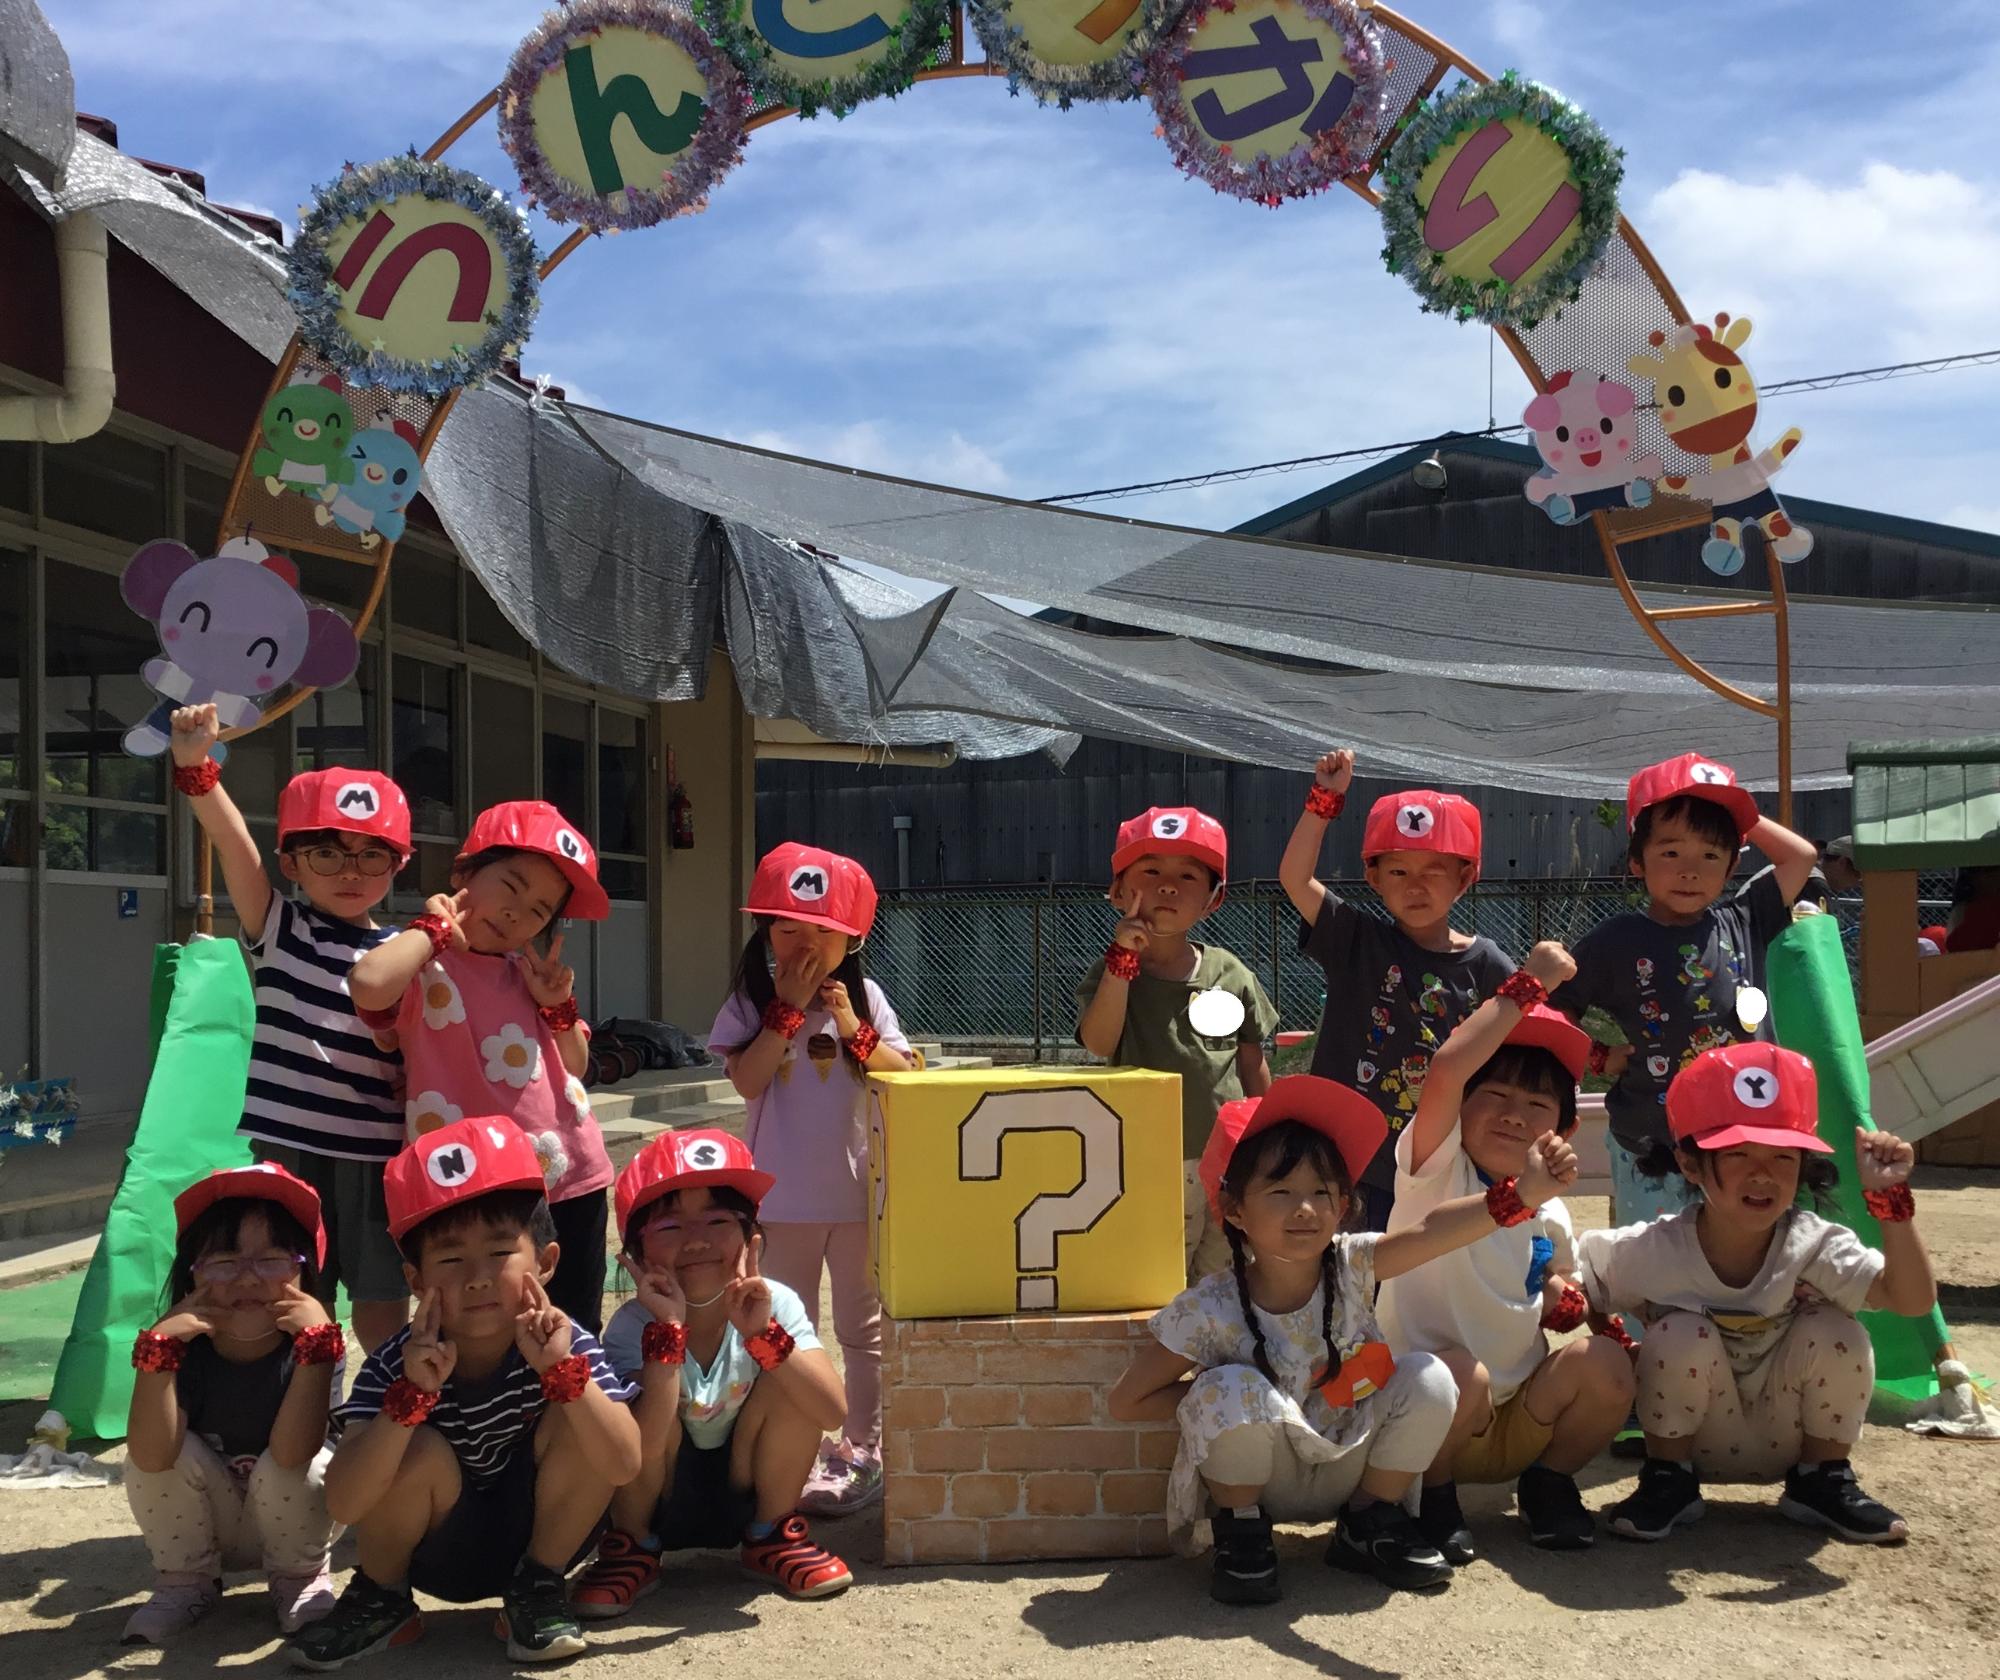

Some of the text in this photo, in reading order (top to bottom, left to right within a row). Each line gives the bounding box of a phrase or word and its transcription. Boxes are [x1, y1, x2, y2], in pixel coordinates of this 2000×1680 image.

[1701, 767, 1716, 782] Y
[338, 790, 375, 812] M
[1161, 818, 1179, 835] S
[1406, 810, 1426, 832] Y
[562, 833, 578, 858] U
[791, 872, 823, 895] M
[1743, 1076, 1767, 1099] Y
[437, 1148, 466, 1180] N
[693, 1145, 716, 1166] S
[957, 1085, 1125, 1312] ?
